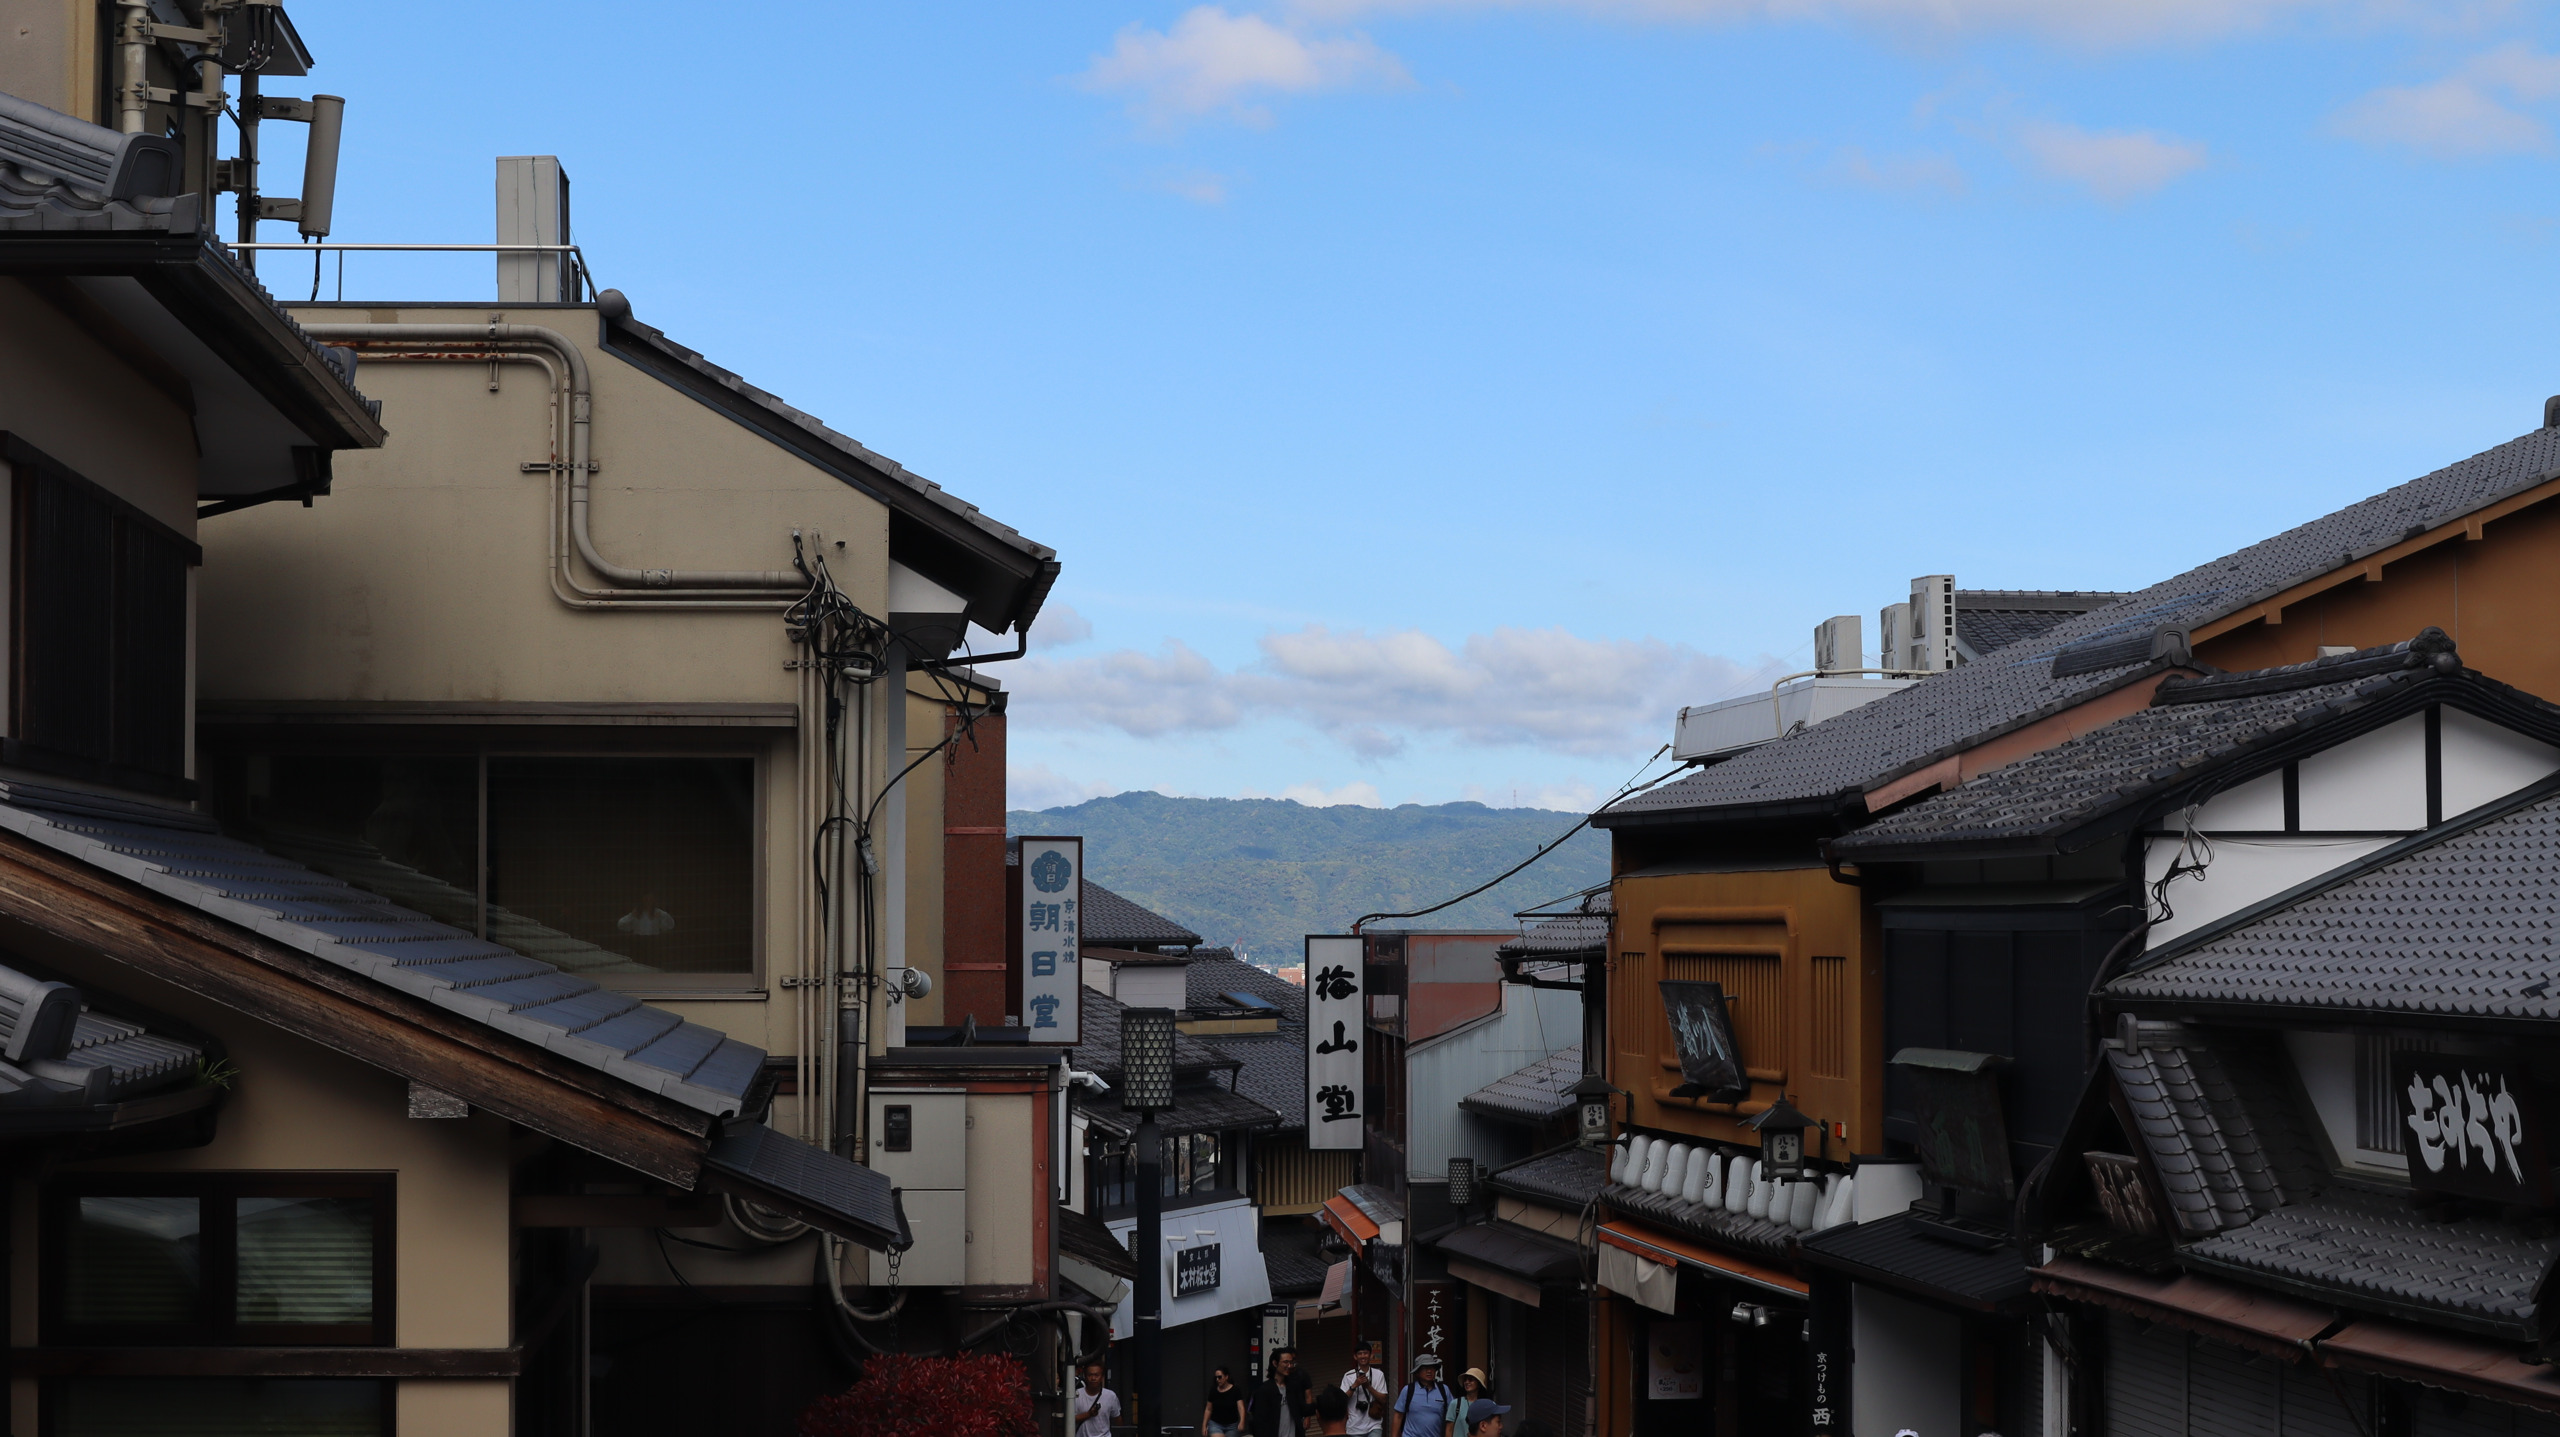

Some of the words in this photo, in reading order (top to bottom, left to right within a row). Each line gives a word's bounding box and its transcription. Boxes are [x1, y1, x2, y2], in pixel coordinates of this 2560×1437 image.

[1029, 900, 1061, 1029] 朝日堂
[1315, 964, 1362, 1123] 梅山堂
[1812, 1407, 1831, 1426] 西
[1816, 1351, 1828, 1404] 京つけもの
